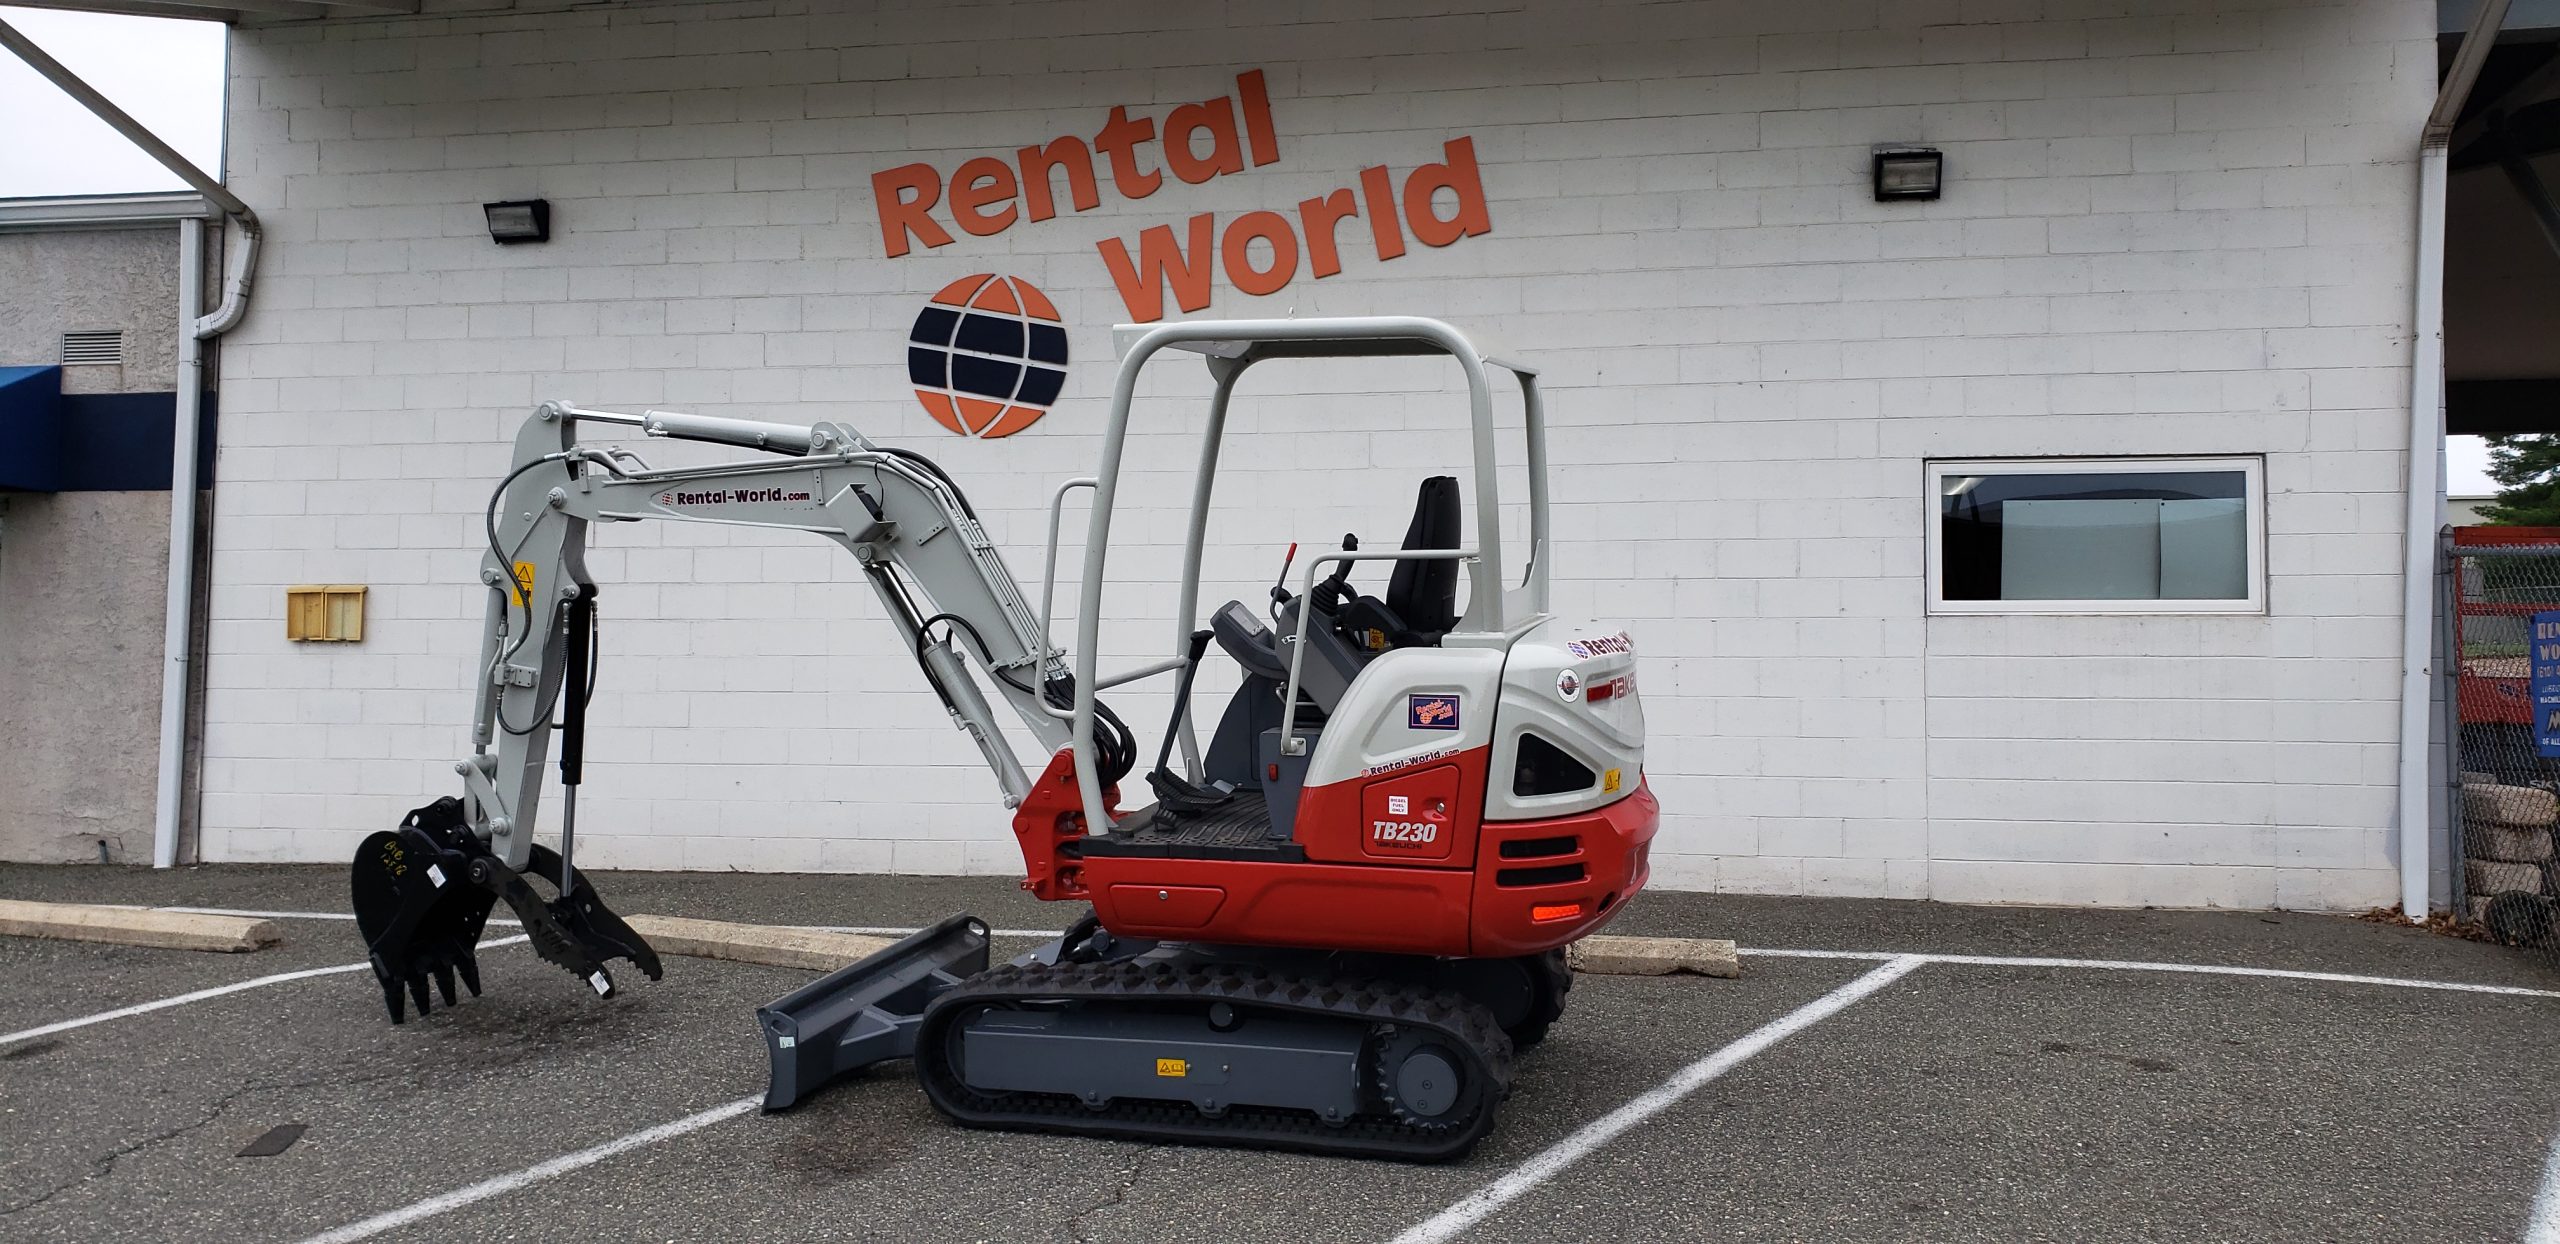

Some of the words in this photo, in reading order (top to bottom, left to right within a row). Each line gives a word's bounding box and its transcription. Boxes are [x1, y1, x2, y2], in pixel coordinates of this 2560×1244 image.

[872, 68, 1281, 258] Rental
[1096, 135, 1493, 323] World
[677, 487, 811, 506] Rental-World.com
[1370, 748, 1460, 776] Rental-World.com
[1373, 820, 1437, 843] TB230
